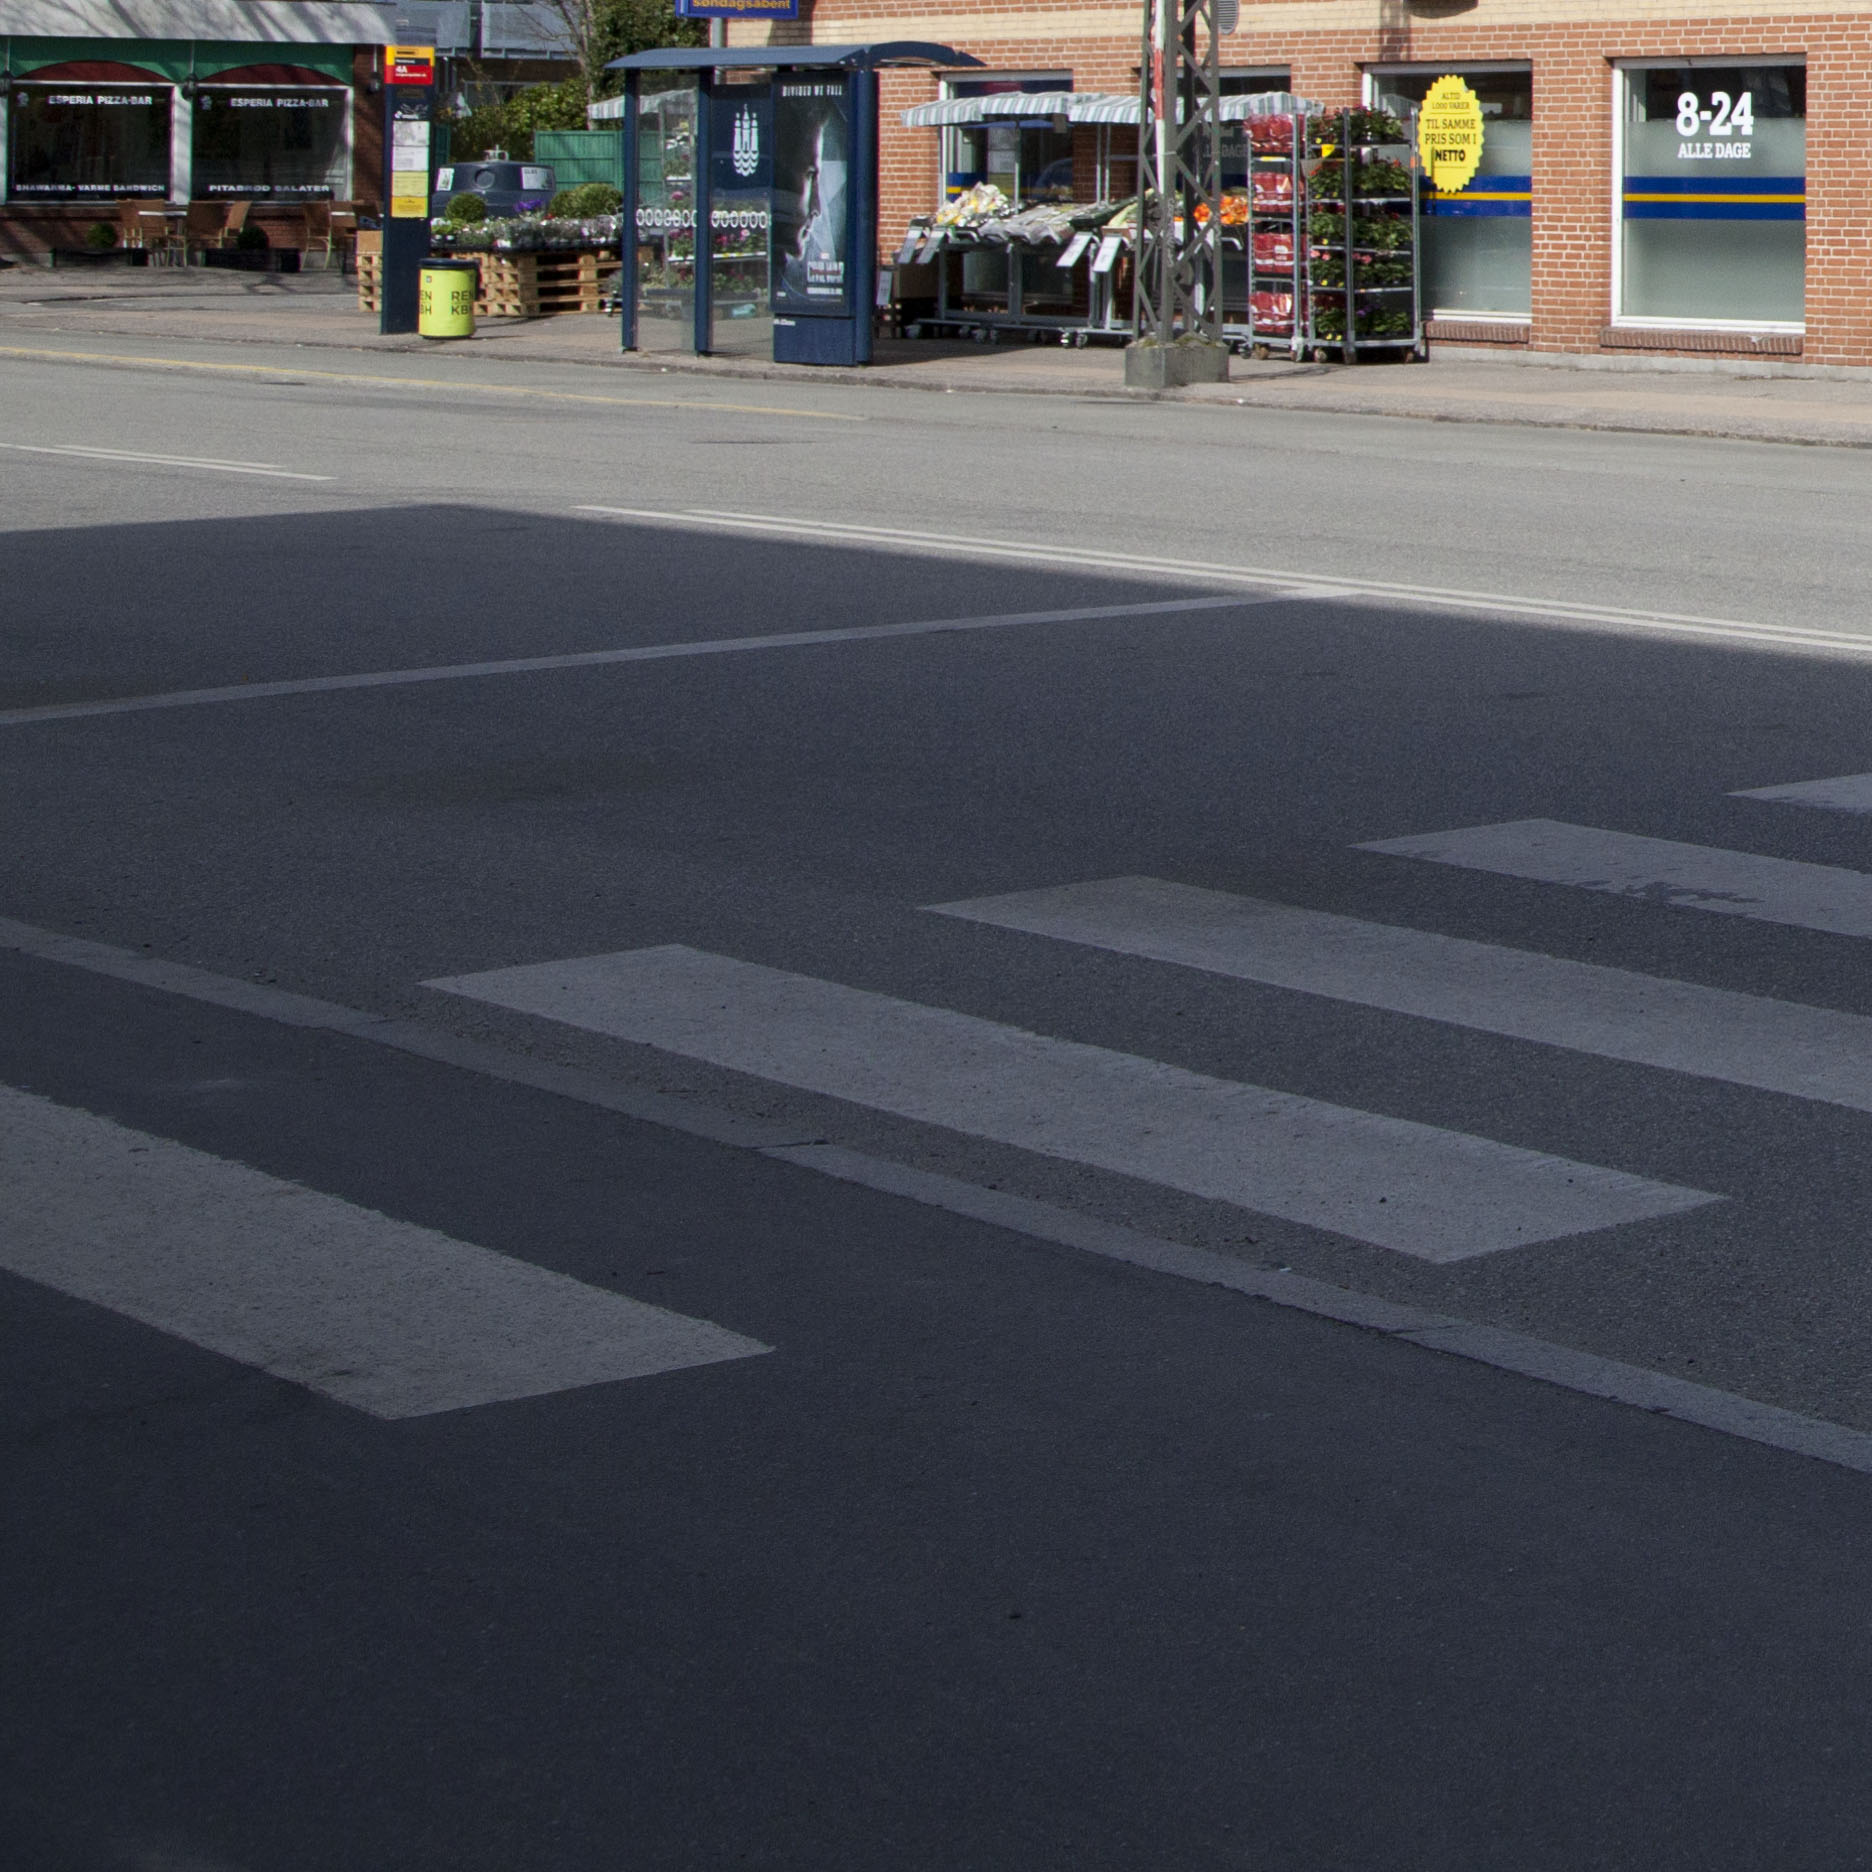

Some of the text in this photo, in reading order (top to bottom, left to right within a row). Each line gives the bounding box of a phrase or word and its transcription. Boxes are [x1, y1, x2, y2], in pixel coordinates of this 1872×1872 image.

[48, 95, 153, 105] ESPERIA PIZZA-BAR
[230, 98, 273, 107] ESPERIA
[1676, 91, 1754, 137] 8-24
[1425, 118, 1476, 129] TIL SAMME
[1424, 133, 1447, 145] PRIS
[1448, 133, 1471, 145] SOM
[1434, 149, 1466, 161] NETTO
[1677, 142, 1752, 159] ALLE DAGE
